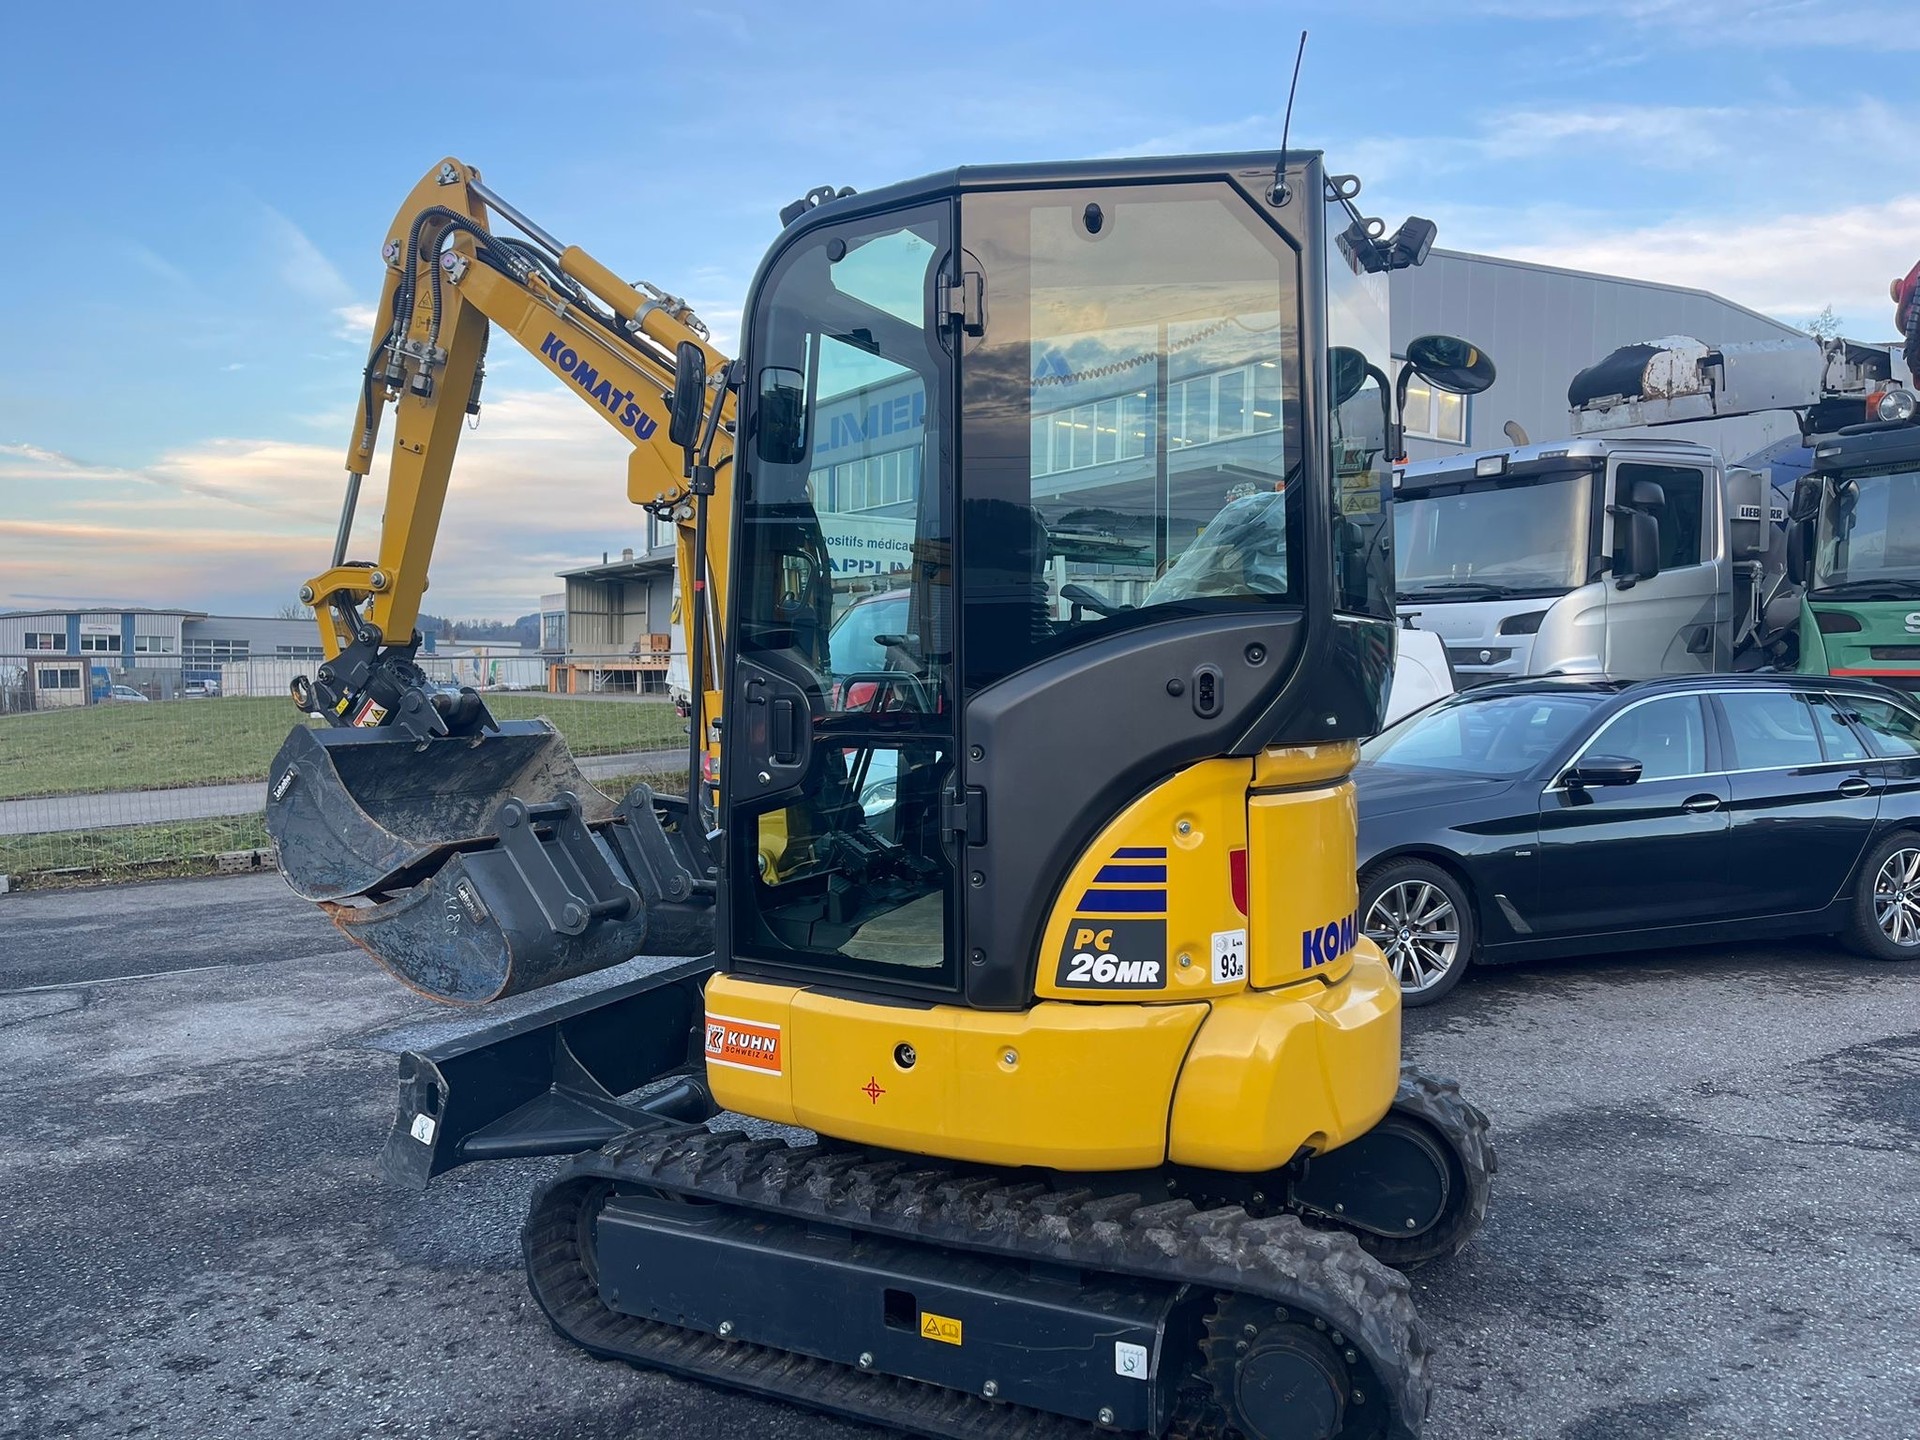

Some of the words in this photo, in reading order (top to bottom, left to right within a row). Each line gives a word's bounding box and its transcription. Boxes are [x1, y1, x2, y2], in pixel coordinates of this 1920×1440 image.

[540, 331, 658, 440] KOMATSU
[816, 391, 924, 453] IME
[1741, 507, 1783, 519] LIEBRR
[273, 770, 295, 798] Lehnho
[1073, 928, 1113, 951] PC
[1066, 953, 1160, 983] 26MR
[725, 1046, 760, 1058] SCHWEIZ
[727, 1031, 777, 1053] KUHN
